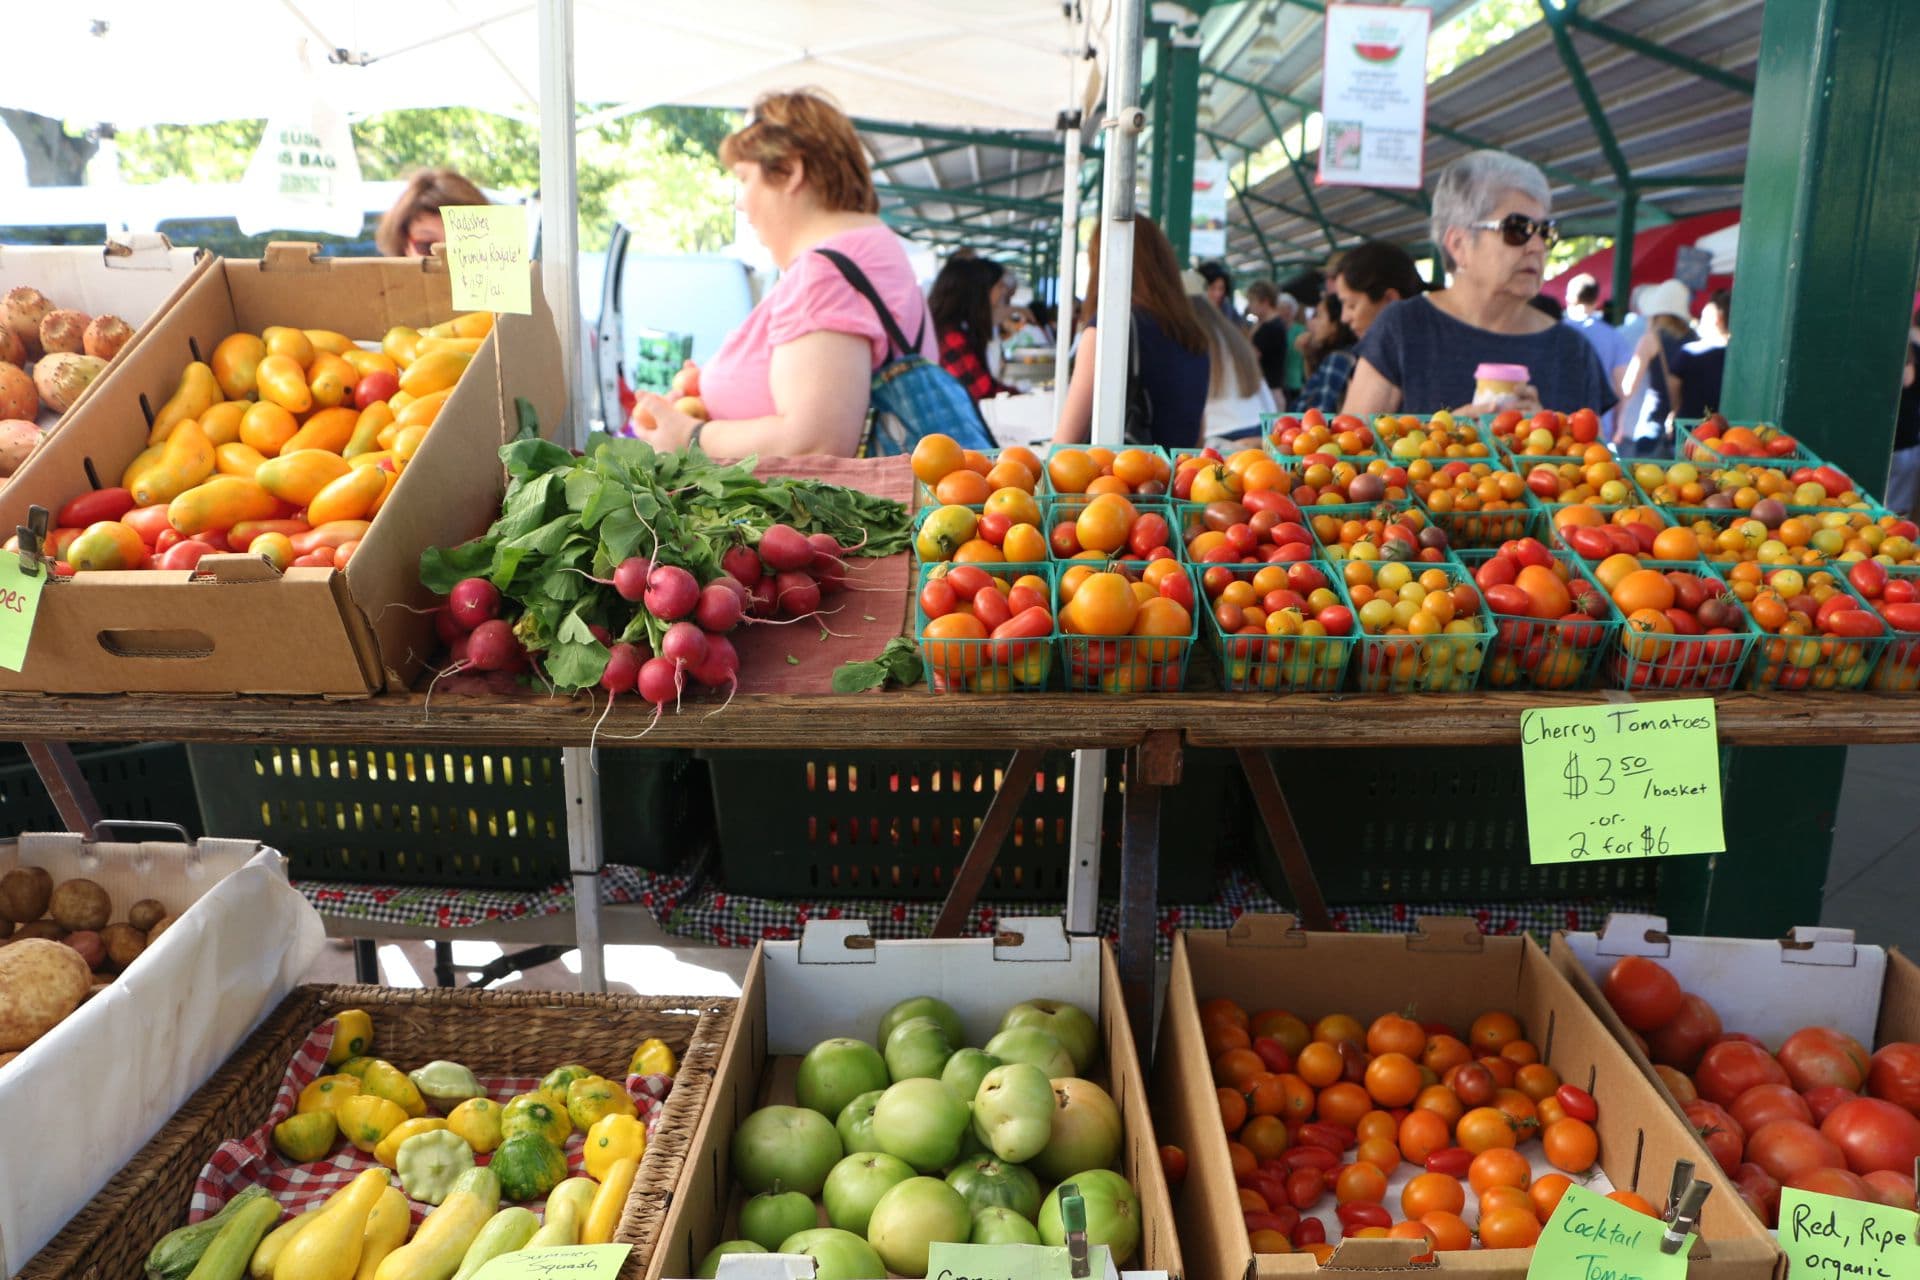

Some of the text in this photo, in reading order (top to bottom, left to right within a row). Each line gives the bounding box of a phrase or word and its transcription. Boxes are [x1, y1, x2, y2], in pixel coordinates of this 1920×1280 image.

[299, 151, 337, 169] BAG
[1521, 709, 1711, 745] Cherry Tomatoes
[1643, 778, 1708, 799] /basket
[1568, 825, 1670, 859] 2 for $6
[1792, 1203, 1907, 1253] Red, Ripe
[1805, 1254, 1891, 1280] organic
